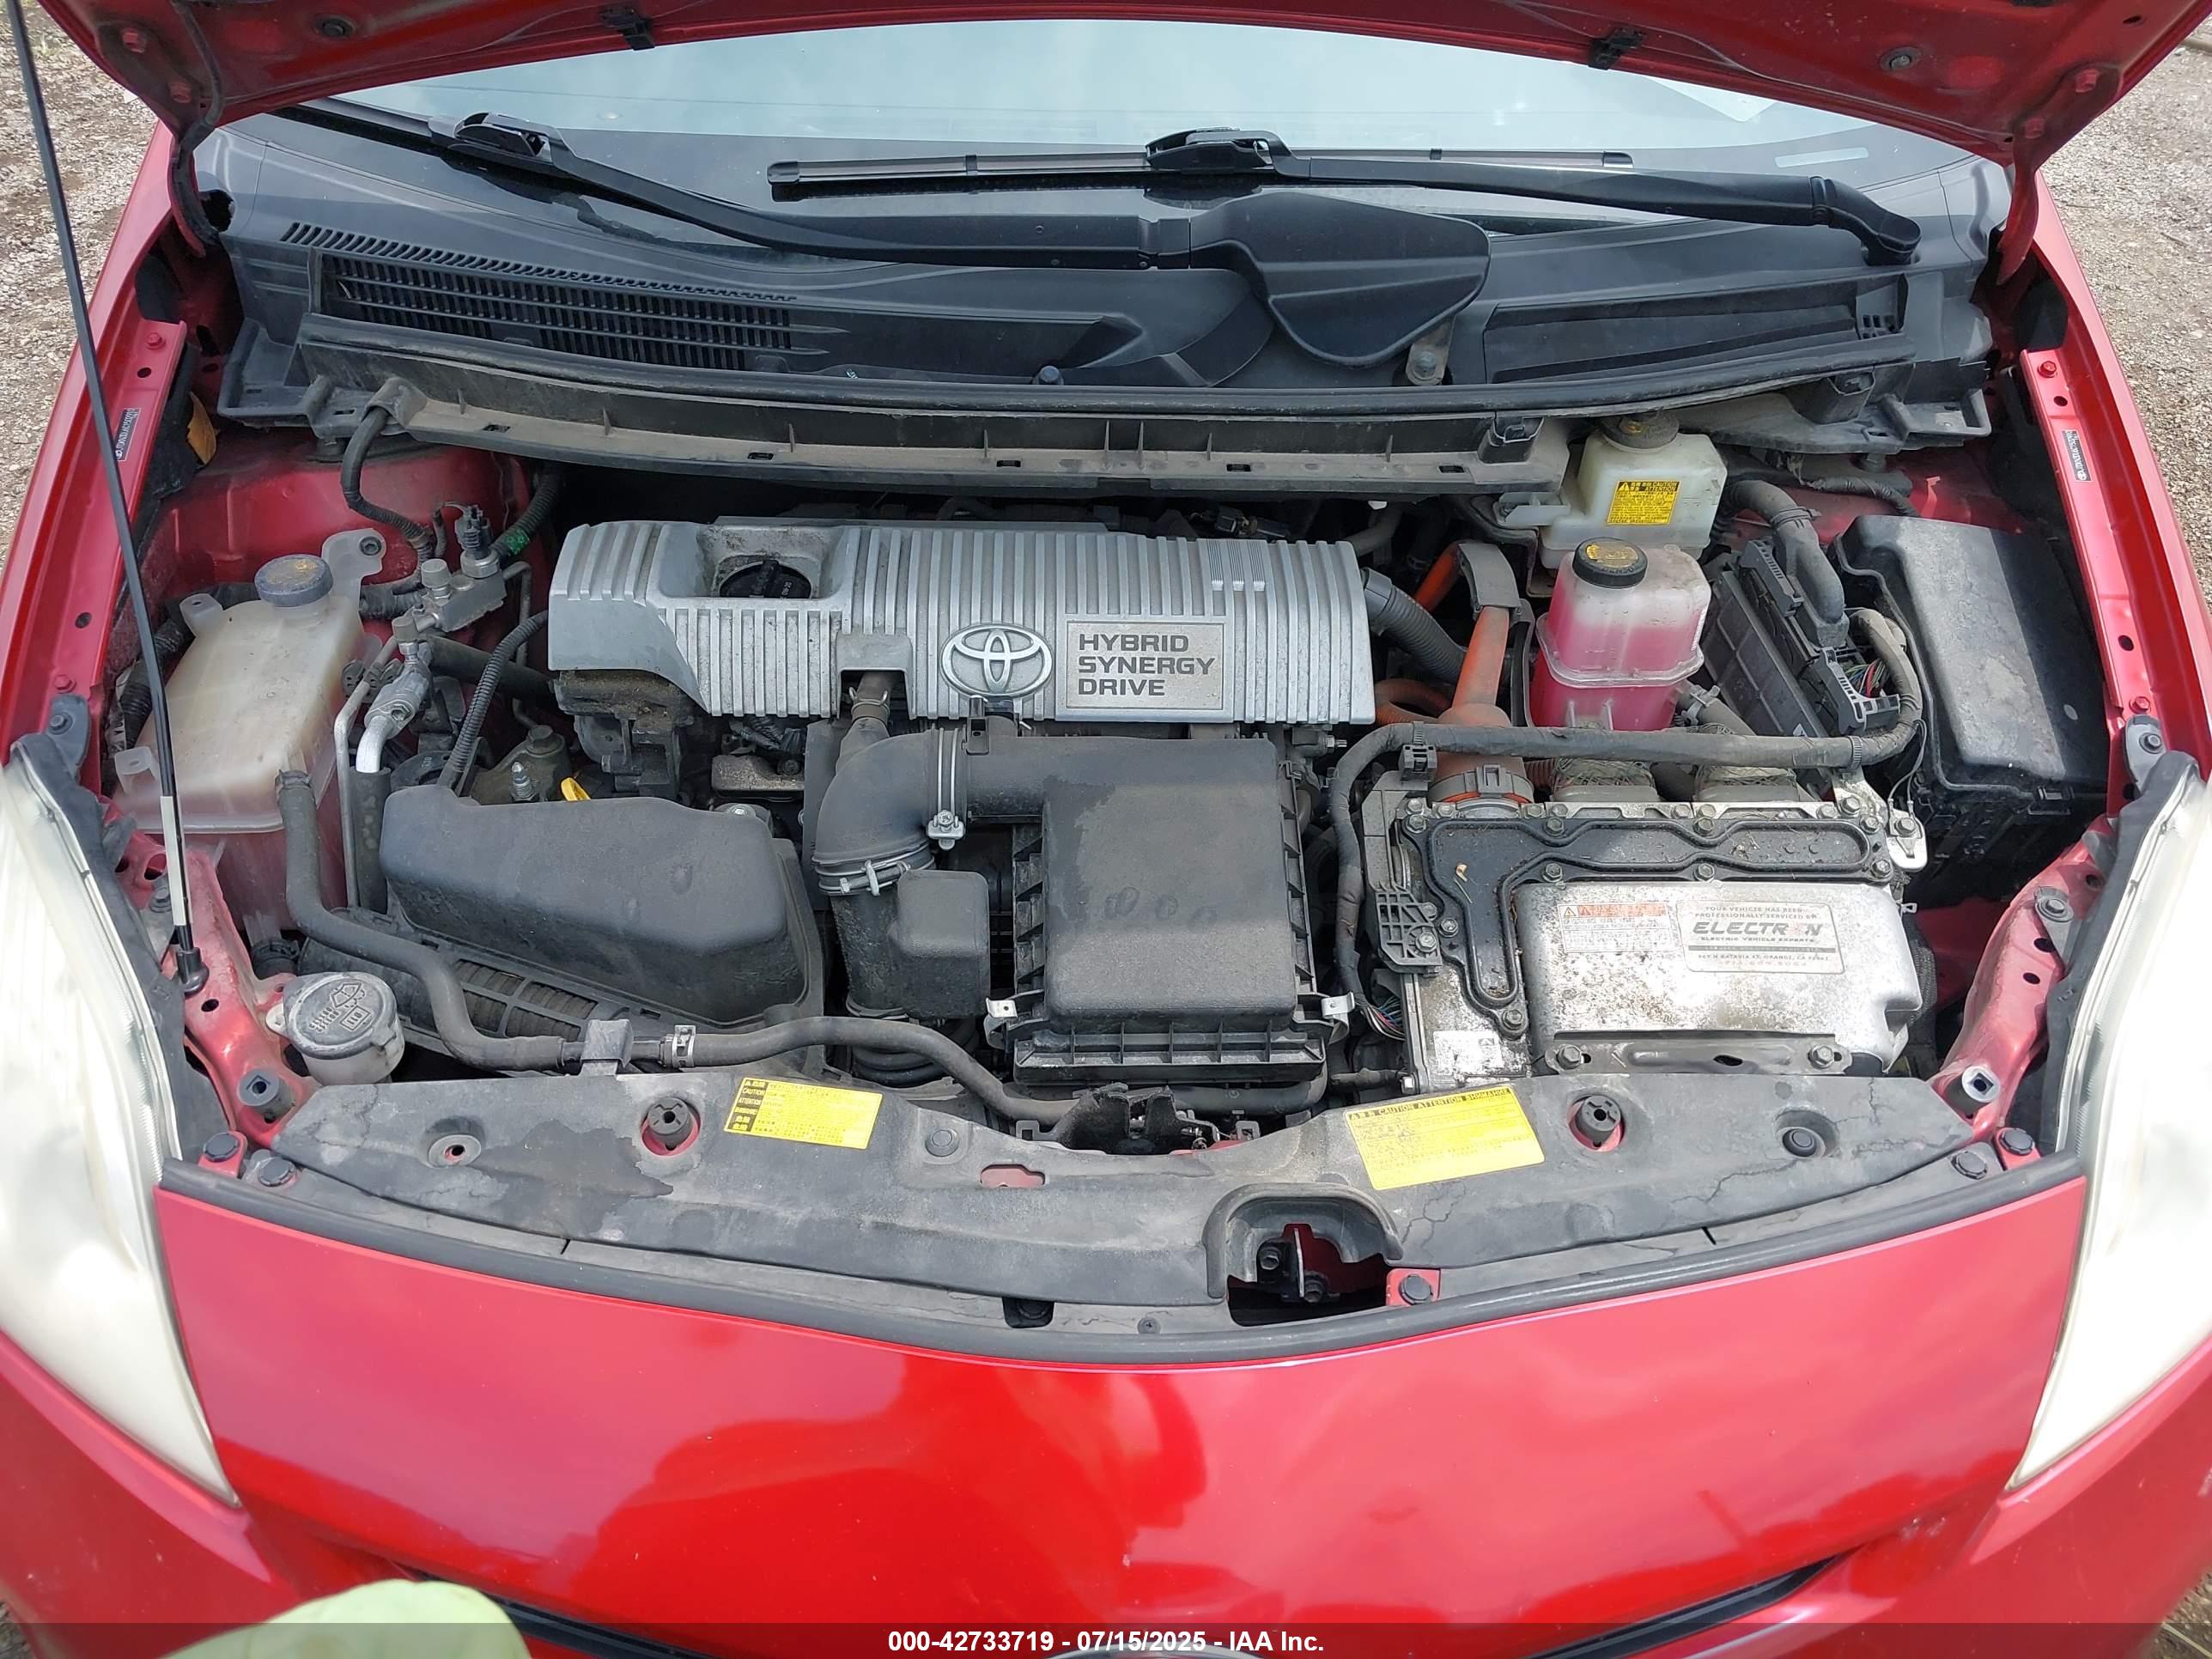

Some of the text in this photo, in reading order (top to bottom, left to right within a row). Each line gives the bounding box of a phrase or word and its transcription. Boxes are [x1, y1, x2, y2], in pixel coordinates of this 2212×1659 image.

[1079, 634, 1189, 652] HYBRID
[1079, 656, 1215, 674] SYNERGY
[1079, 678, 1165, 696] DRIVE
[1379, 1102, 1414, 1115] CAUTION
